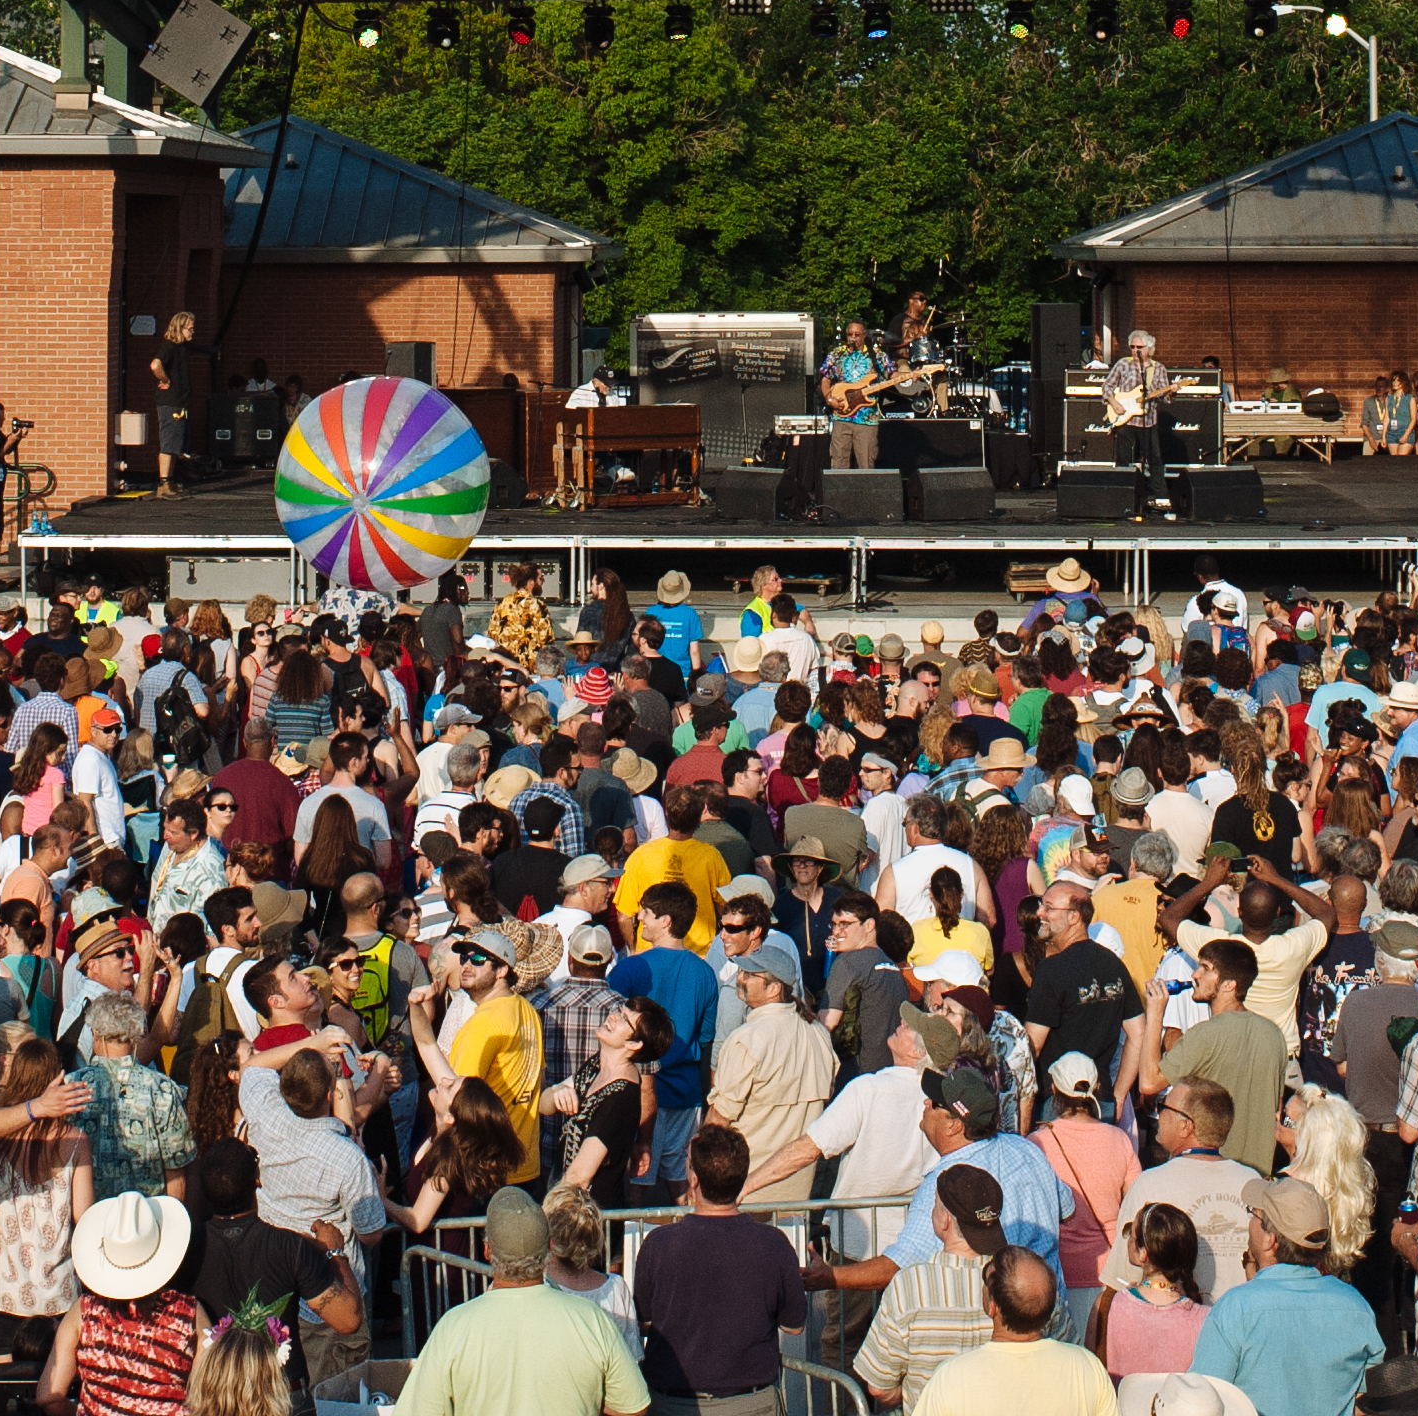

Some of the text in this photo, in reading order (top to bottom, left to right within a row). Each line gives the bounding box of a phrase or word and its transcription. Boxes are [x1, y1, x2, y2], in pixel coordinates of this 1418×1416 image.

[731, 342, 791, 353] Band Instruments
[685, 349, 716, 359] LAFAYETTE
[735, 350, 786, 359] Organs, Pianos
[692, 356, 710, 364] MUSIC
[745, 358, 781, 368] Keyboards
[689, 360, 717, 371] COMPANY
[733, 365, 758, 373] Guitars
[766, 366, 786, 375] Amps
[737, 372, 751, 380] P.A.
[758, 374, 781, 382] Drums
[1186, 1193, 1212, 1218] HAPPY
